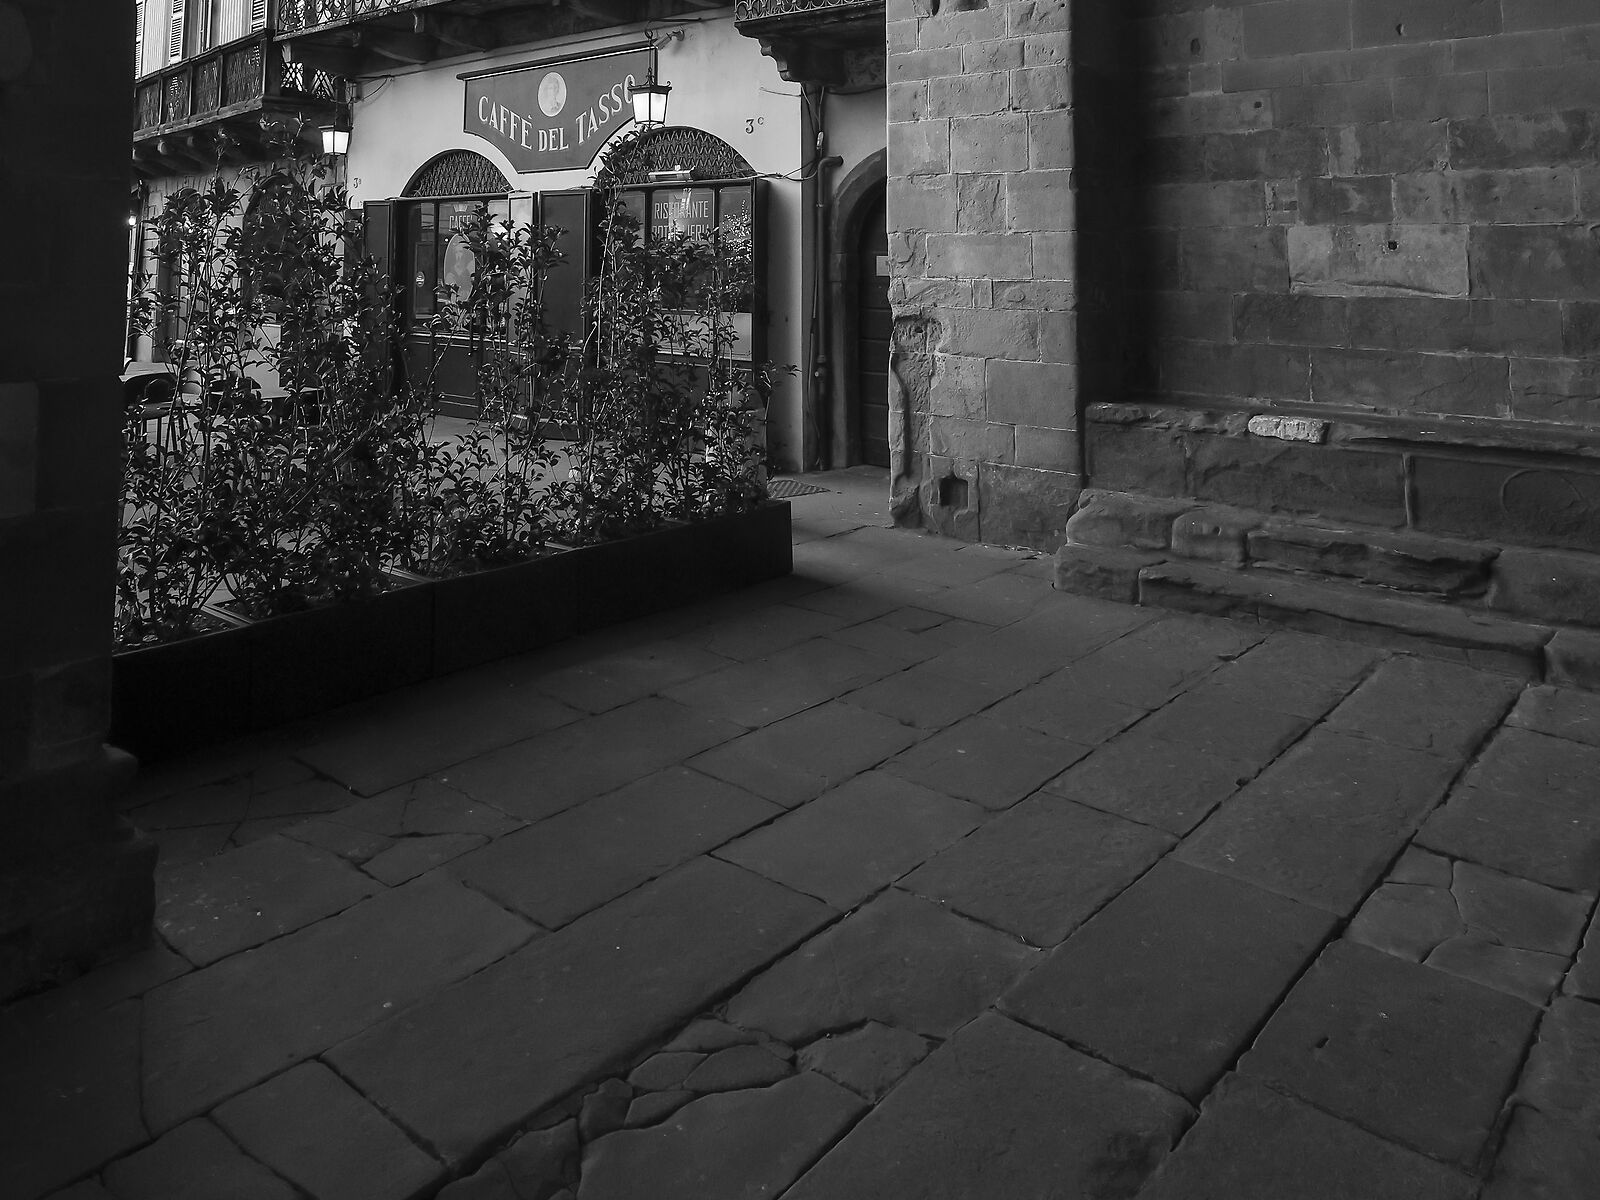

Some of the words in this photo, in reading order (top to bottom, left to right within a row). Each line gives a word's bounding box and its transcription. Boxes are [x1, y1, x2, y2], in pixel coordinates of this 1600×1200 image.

[478, 95, 533, 150] CAFFÈ
[538, 127, 569, 152] DEL
[575, 74, 636, 145] TASSO
